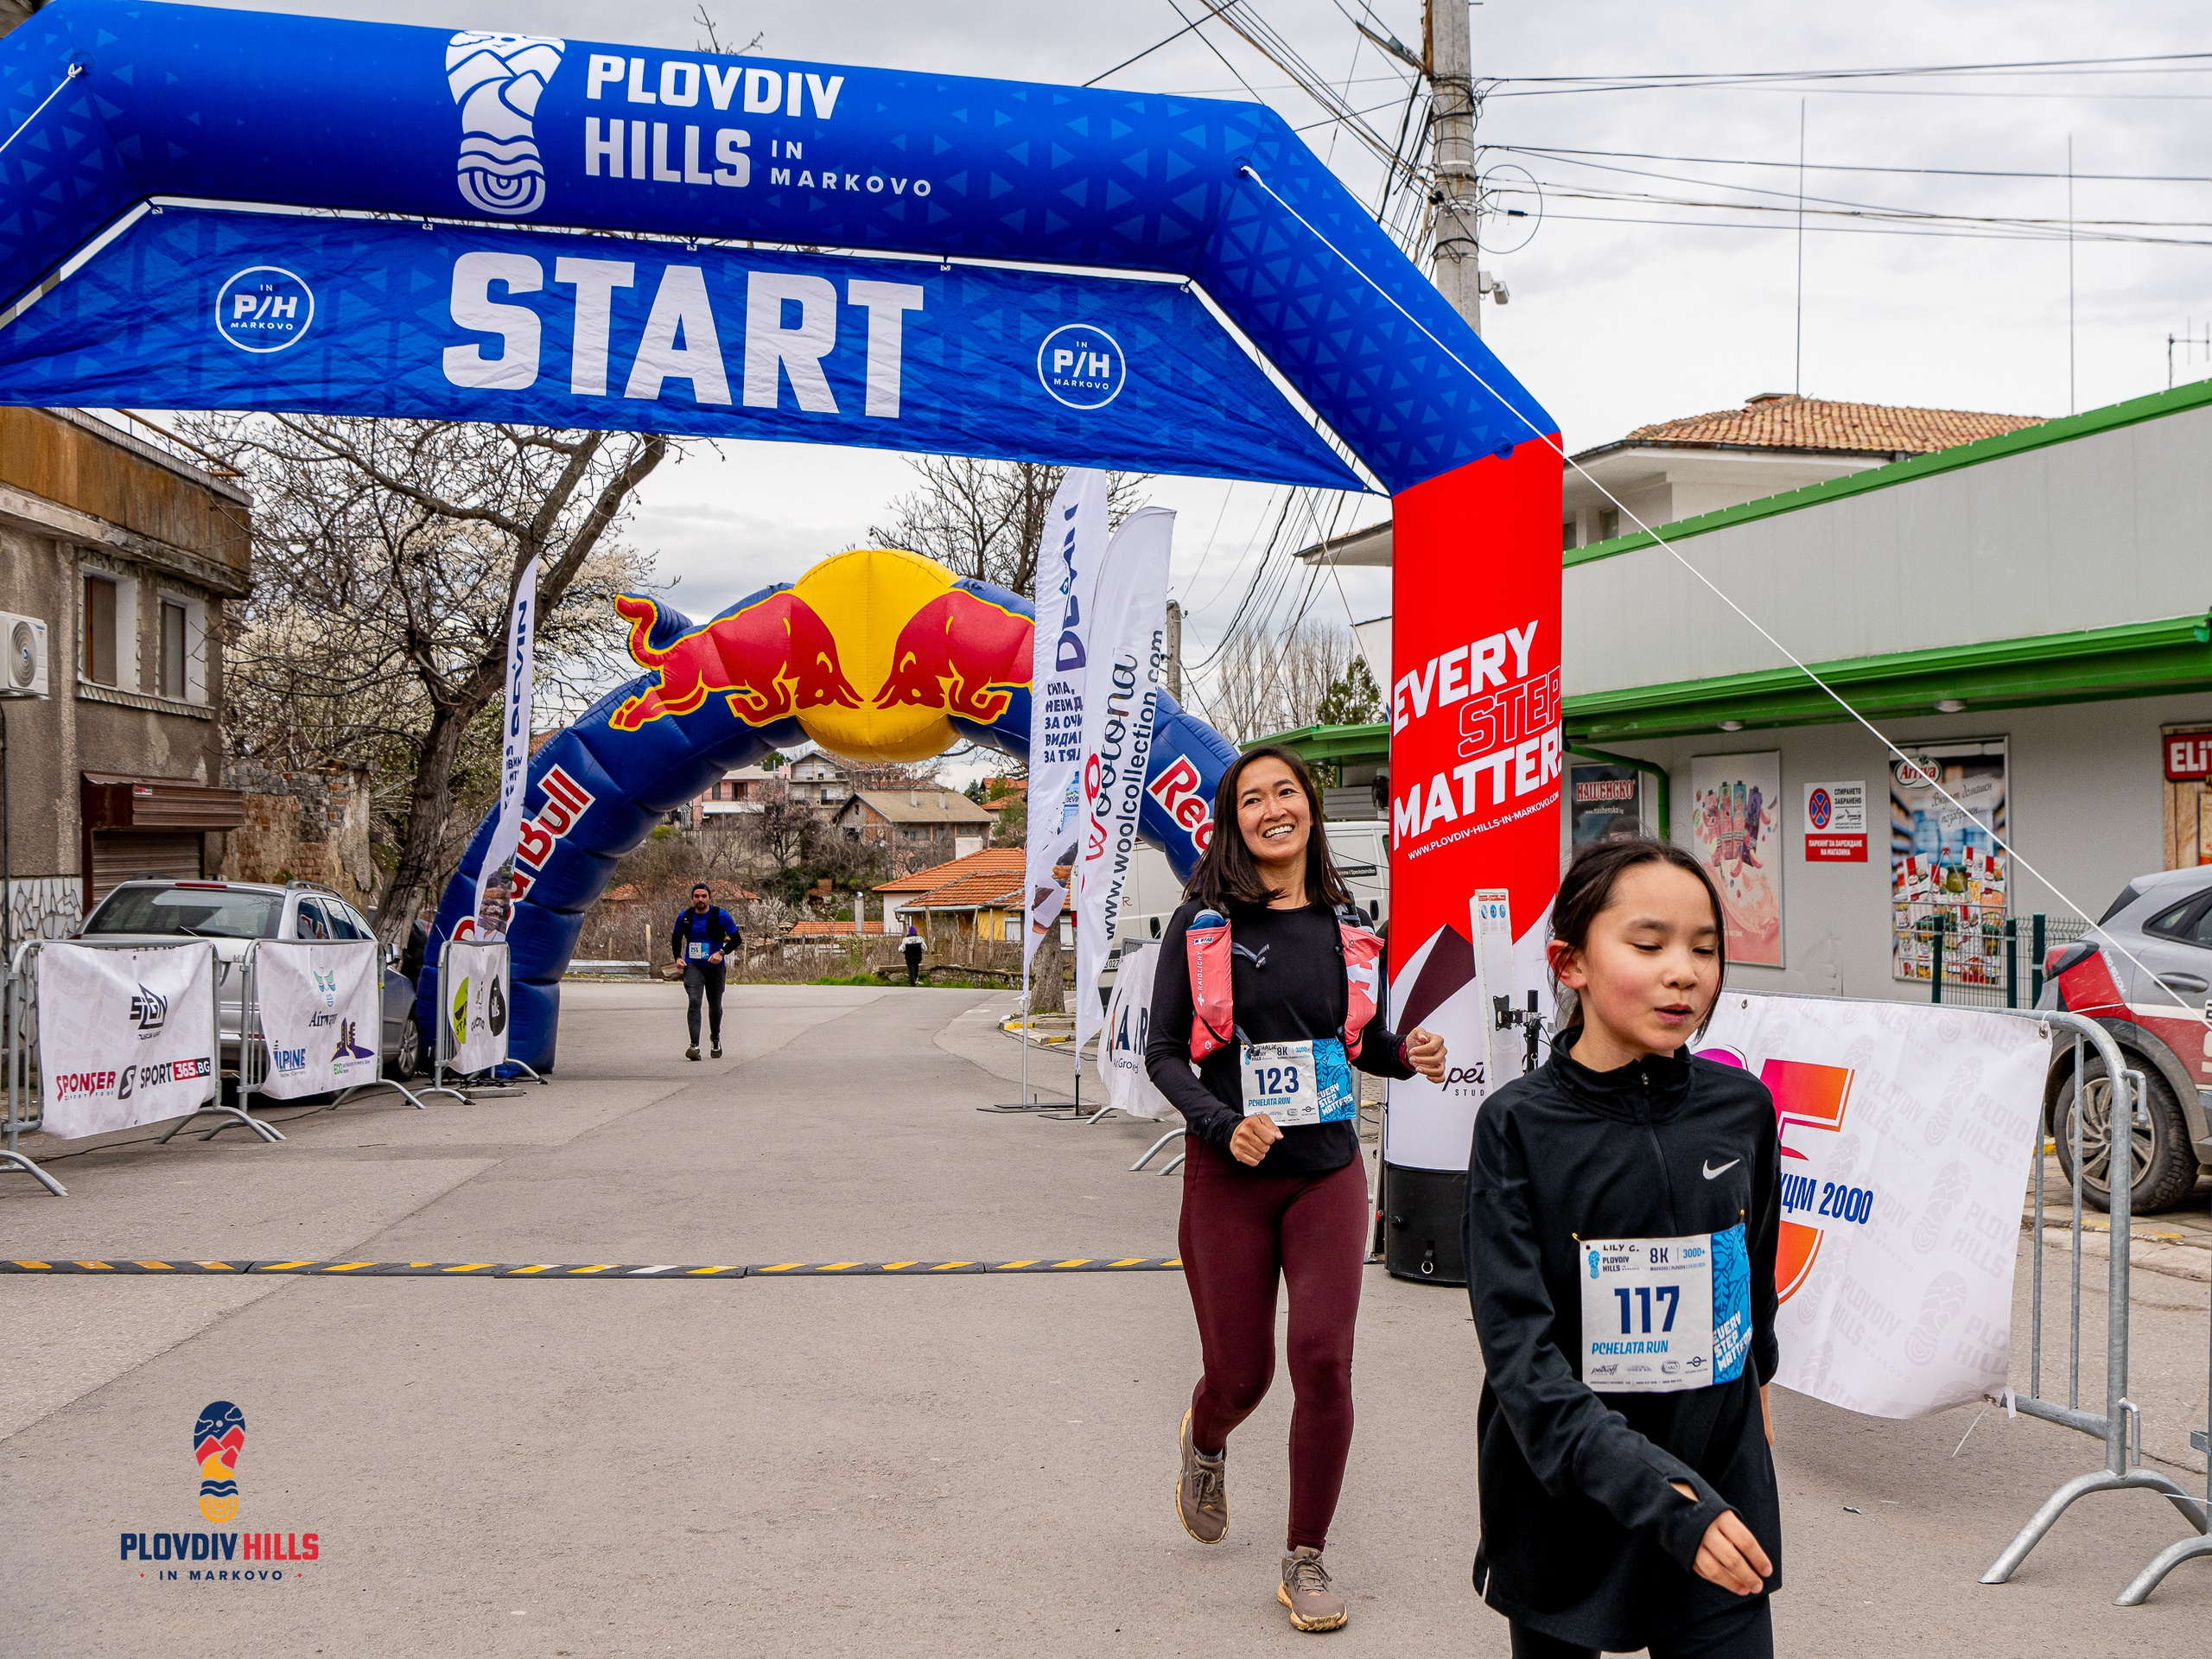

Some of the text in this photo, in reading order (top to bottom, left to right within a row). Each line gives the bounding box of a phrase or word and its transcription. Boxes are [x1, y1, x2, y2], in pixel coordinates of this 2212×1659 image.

[586, 54, 844, 119] PLOVDIV
[585, 117, 751, 188] HILLS
[772, 139, 803, 159] IN
[772, 168, 931, 197] MARKOVO
[231, 321, 294, 330] MARKOVO
[442, 251, 924, 418] START
[1053, 378, 1109, 390] MARKOVO
[1047, 682, 1075, 696] СИЛА,
[1393, 620, 1538, 737] EVERY
[1045, 716, 1060, 730] ЗА
[1458, 665, 1560, 758] STEP
[1044, 750, 1056, 763] ЗА
[1576, 780, 1633, 801] НАШЕНСКО
[1408, 791, 1560, 860] WWW.PLOVDIV-HILLS-IN-MARKOVO.COM
[1277, 1046, 1287, 1055] 8K
[56, 1071, 116, 1102] SPONSER
[1255, 1066, 1299, 1095] 123
[1249, 1098, 1277, 1107] PCHELATA
[1318, 1094, 1337, 1108] STEP
[1818, 1182, 1873, 1224] 2000
[1649, 1247, 1669, 1263] 8K
[1614, 1286, 1680, 1334] 117
[1592, 1340, 1668, 1355] PCHELATA RUN
[1713, 1330, 1738, 1359] STEP
